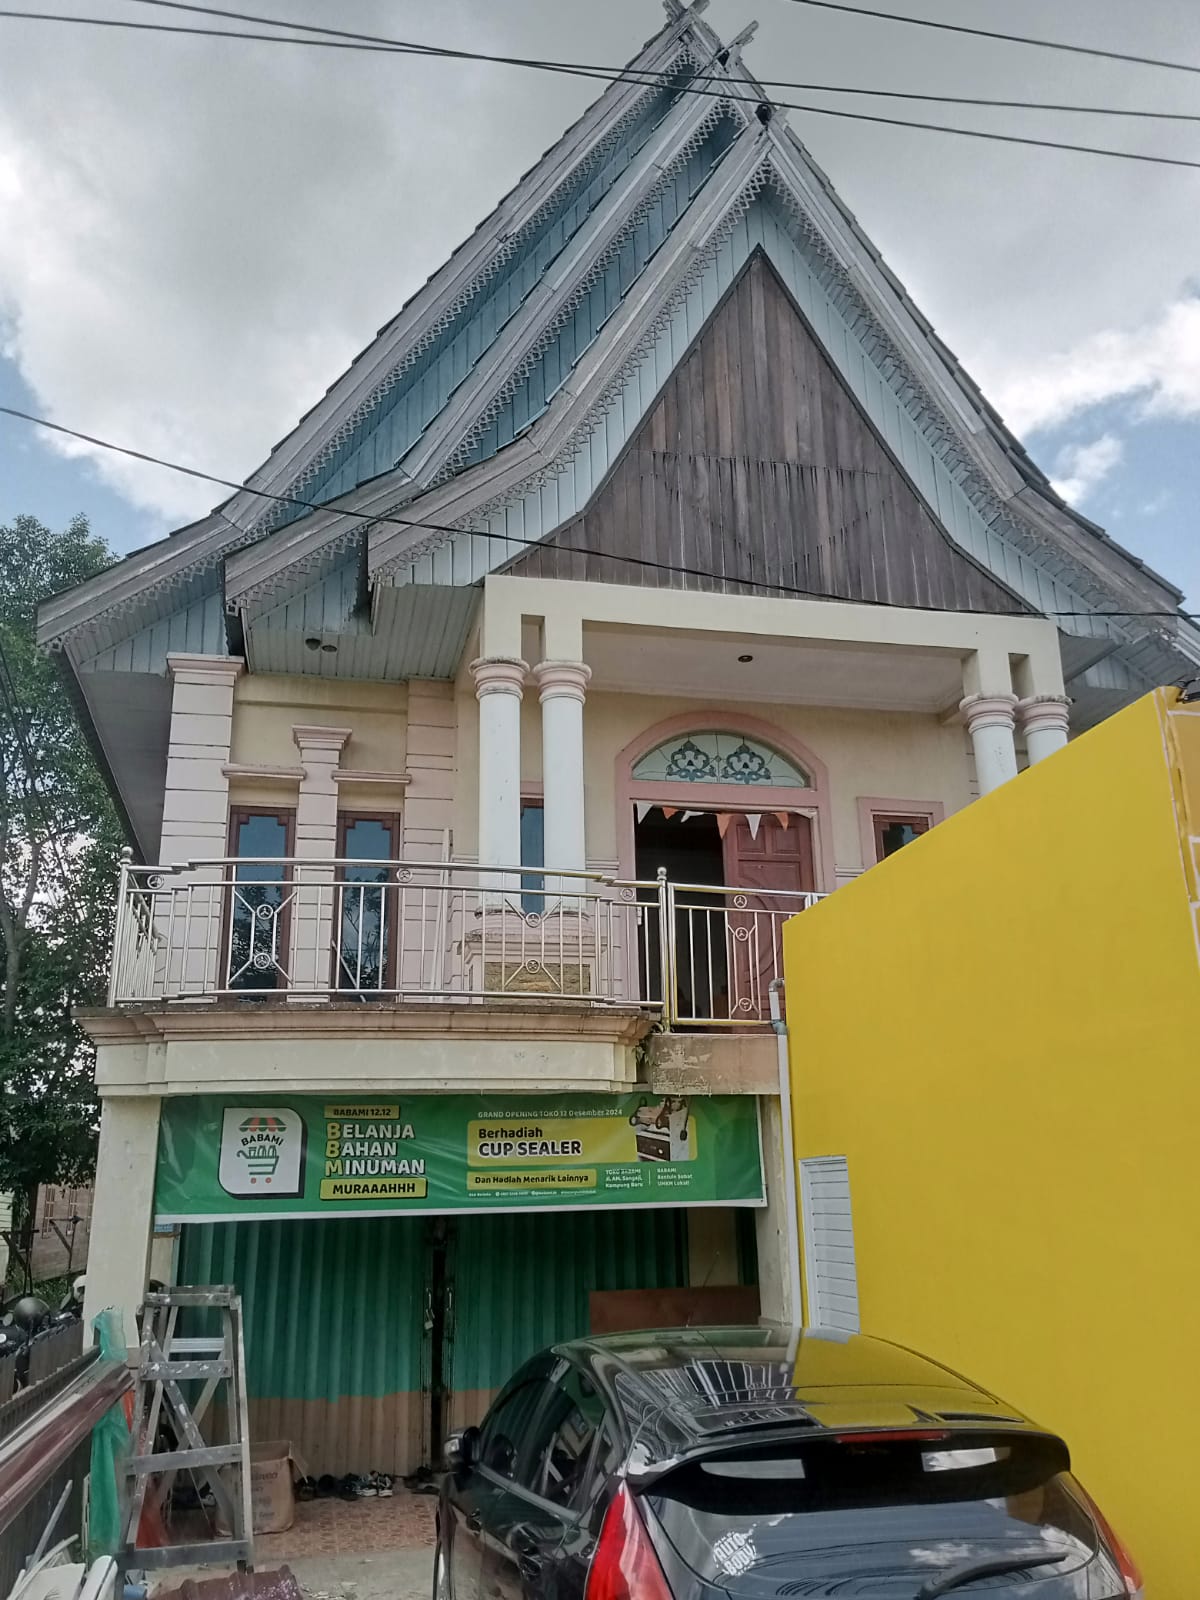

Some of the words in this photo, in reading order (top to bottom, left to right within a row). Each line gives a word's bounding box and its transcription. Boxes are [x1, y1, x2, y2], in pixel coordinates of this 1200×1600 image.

[333, 1108, 369, 1117] BABAMI
[370, 1108, 391, 1116] 12.12
[241, 1133, 284, 1146] BABAMI
[326, 1122, 415, 1140] BELANJA
[478, 1127, 543, 1138] Berhadiah
[325, 1140, 398, 1158] BAHAN
[478, 1141, 514, 1157] CUP
[517, 1140, 582, 1156] SEALER
[325, 1159, 425, 1177] MINUMAN
[475, 1176, 491, 1184] Dan
[492, 1175, 520, 1184] Hadiah
[523, 1175, 556, 1183] Menarik
[557, 1174, 589, 1184] Lainnya
[332, 1183, 416, 1195] MURAAAHHH
[714, 1533, 746, 1562] AUTO
[724, 1543, 755, 1576] BODY
